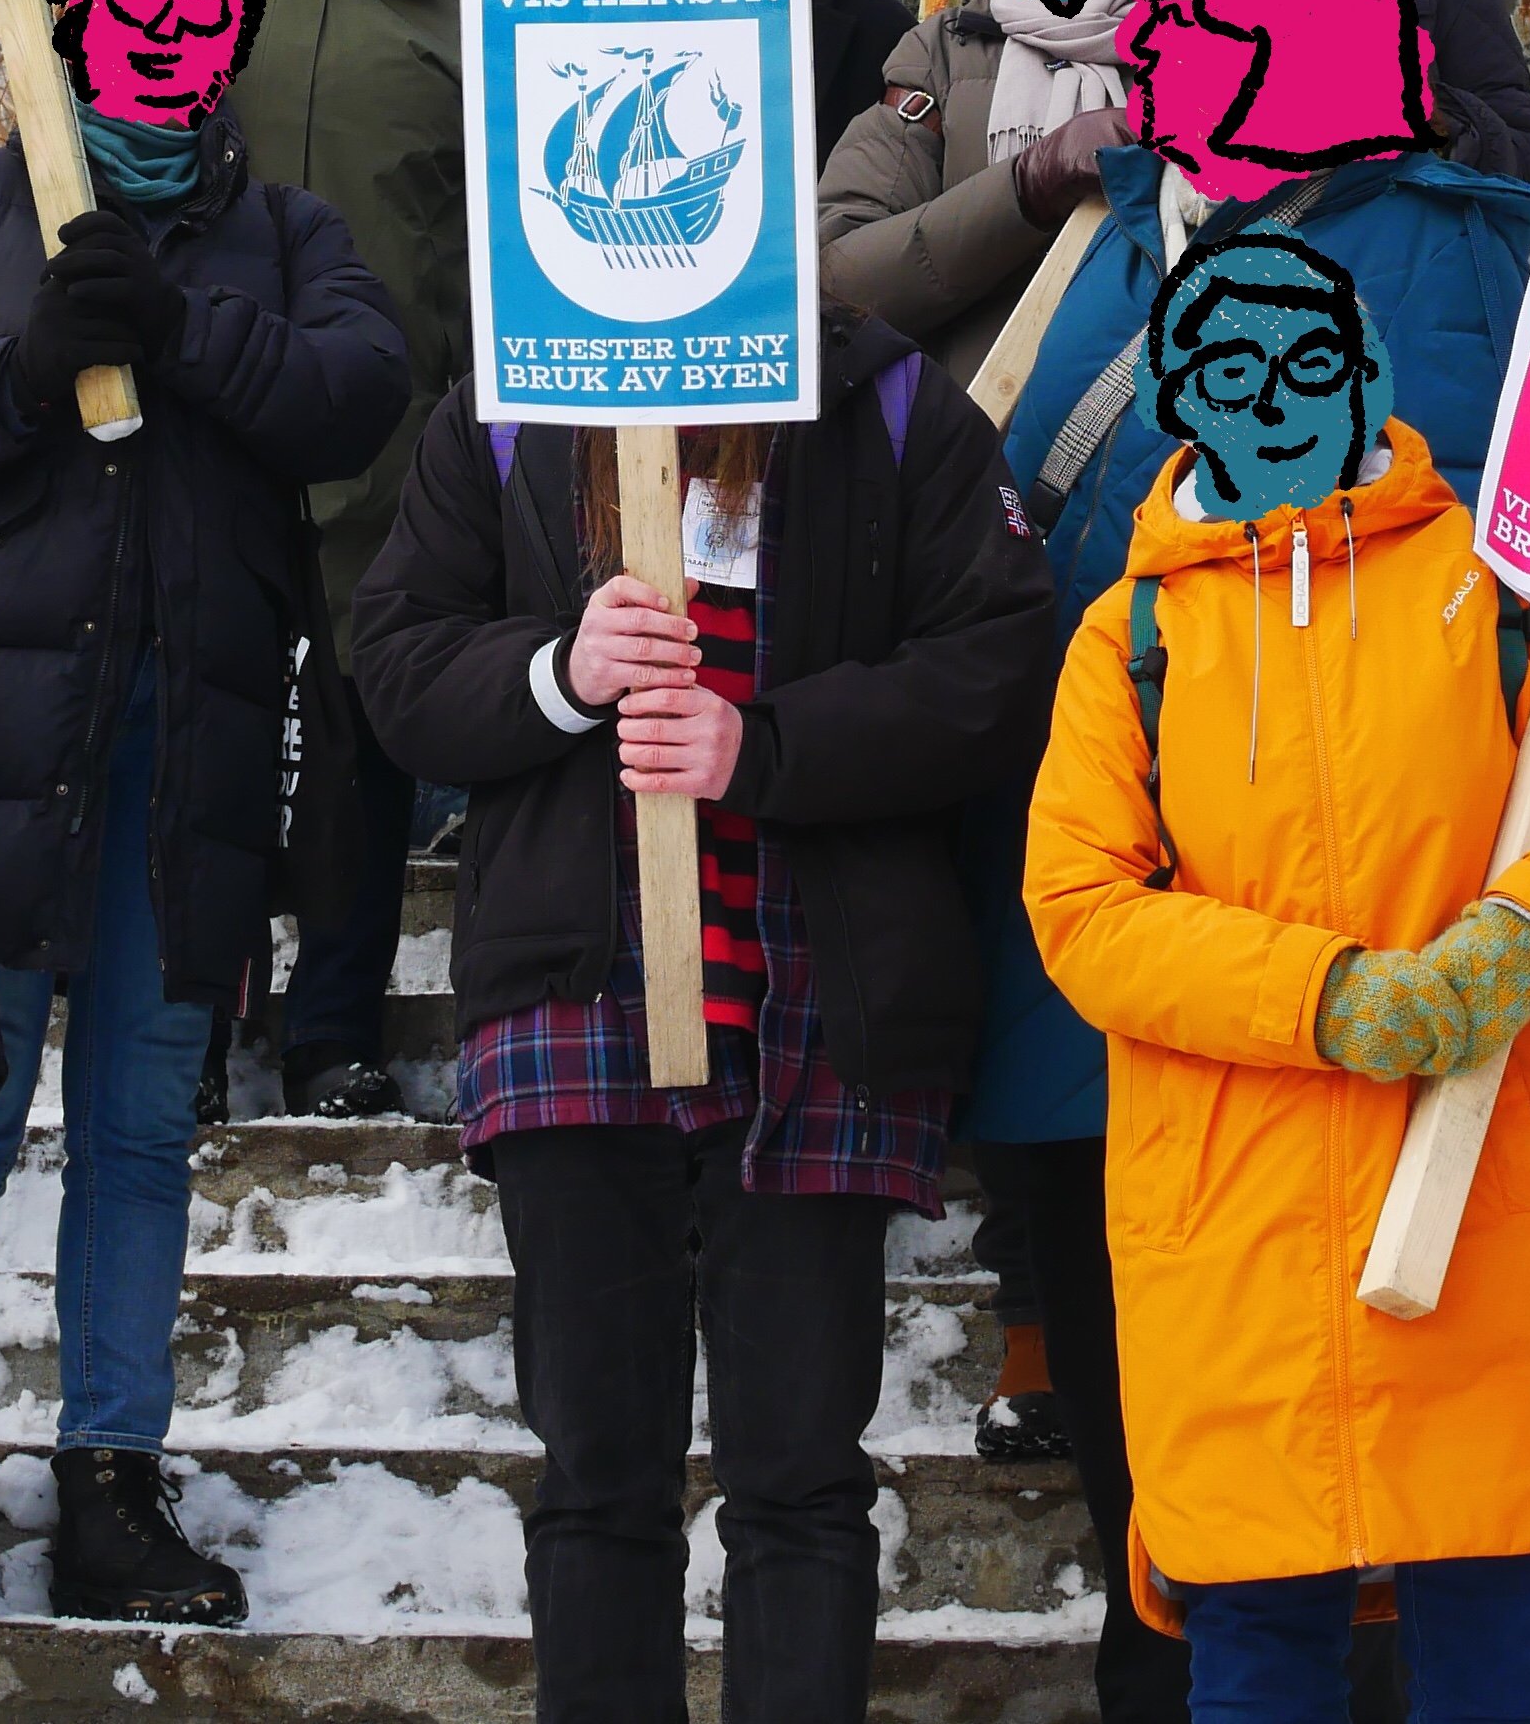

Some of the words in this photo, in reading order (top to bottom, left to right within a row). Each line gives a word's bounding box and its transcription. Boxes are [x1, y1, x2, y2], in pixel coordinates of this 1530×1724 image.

[502, 337, 537, 358] VI
[545, 339, 676, 360] TESTER
[684, 337, 731, 358] UT
[740, 334, 788, 356] NY
[504, 365, 608, 391] BRUK
[618, 366, 671, 391] AV
[682, 362, 789, 389] BYEN
[1503, 488, 1530, 522] VI
[1442, 570, 1480, 625] JOHAUG
